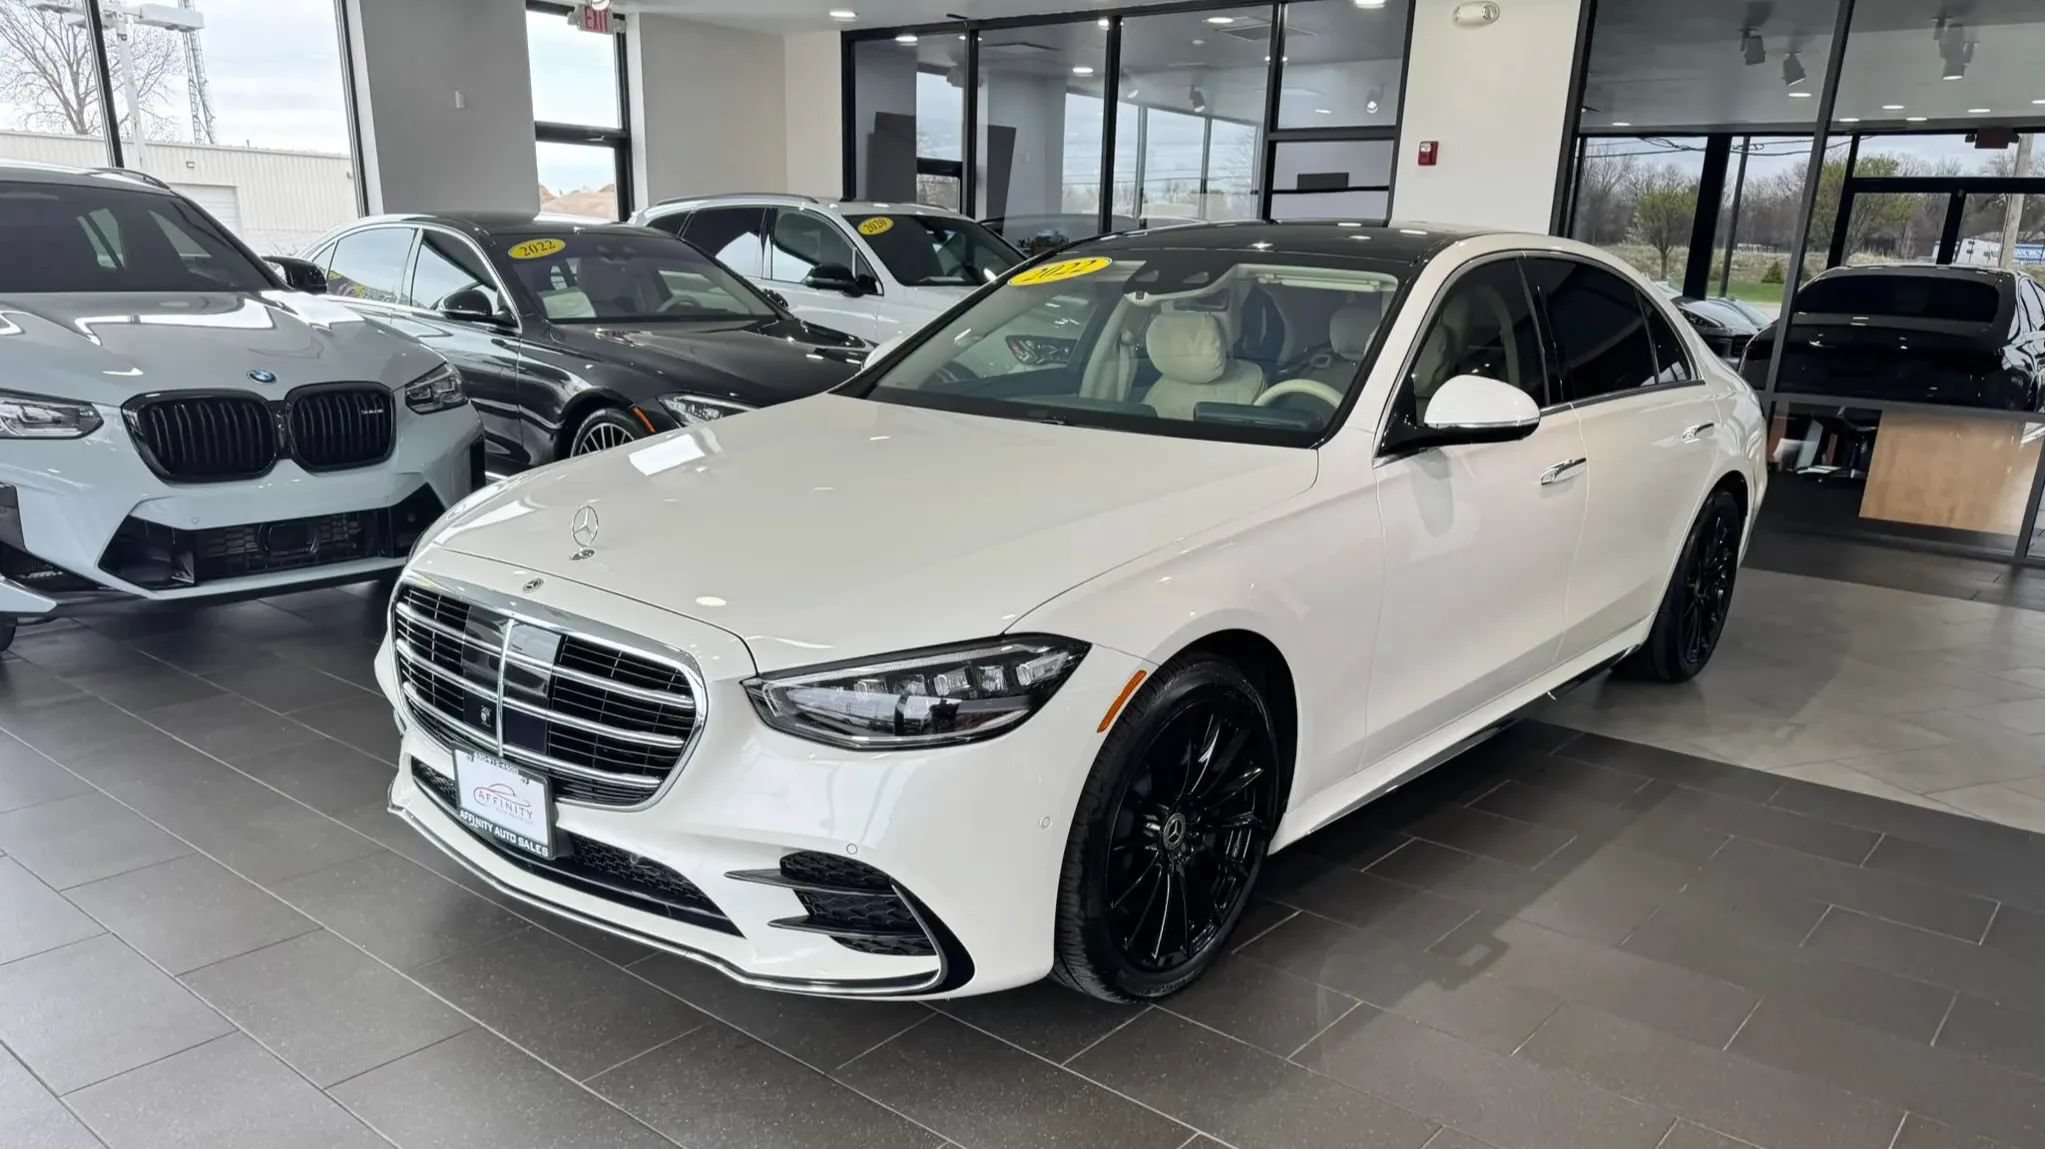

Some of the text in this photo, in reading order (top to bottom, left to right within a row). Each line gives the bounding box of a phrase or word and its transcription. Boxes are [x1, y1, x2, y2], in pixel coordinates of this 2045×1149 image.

[585, 6, 609, 32] EXIT
[519, 240, 556, 257] 2022
[1020, 259, 1097, 282] 2022
[478, 790, 533, 819] AFFINITY
[460, 810, 494, 832] AFFINITY
[494, 826, 517, 844] AUTO
[518, 837, 549, 857] SALES
